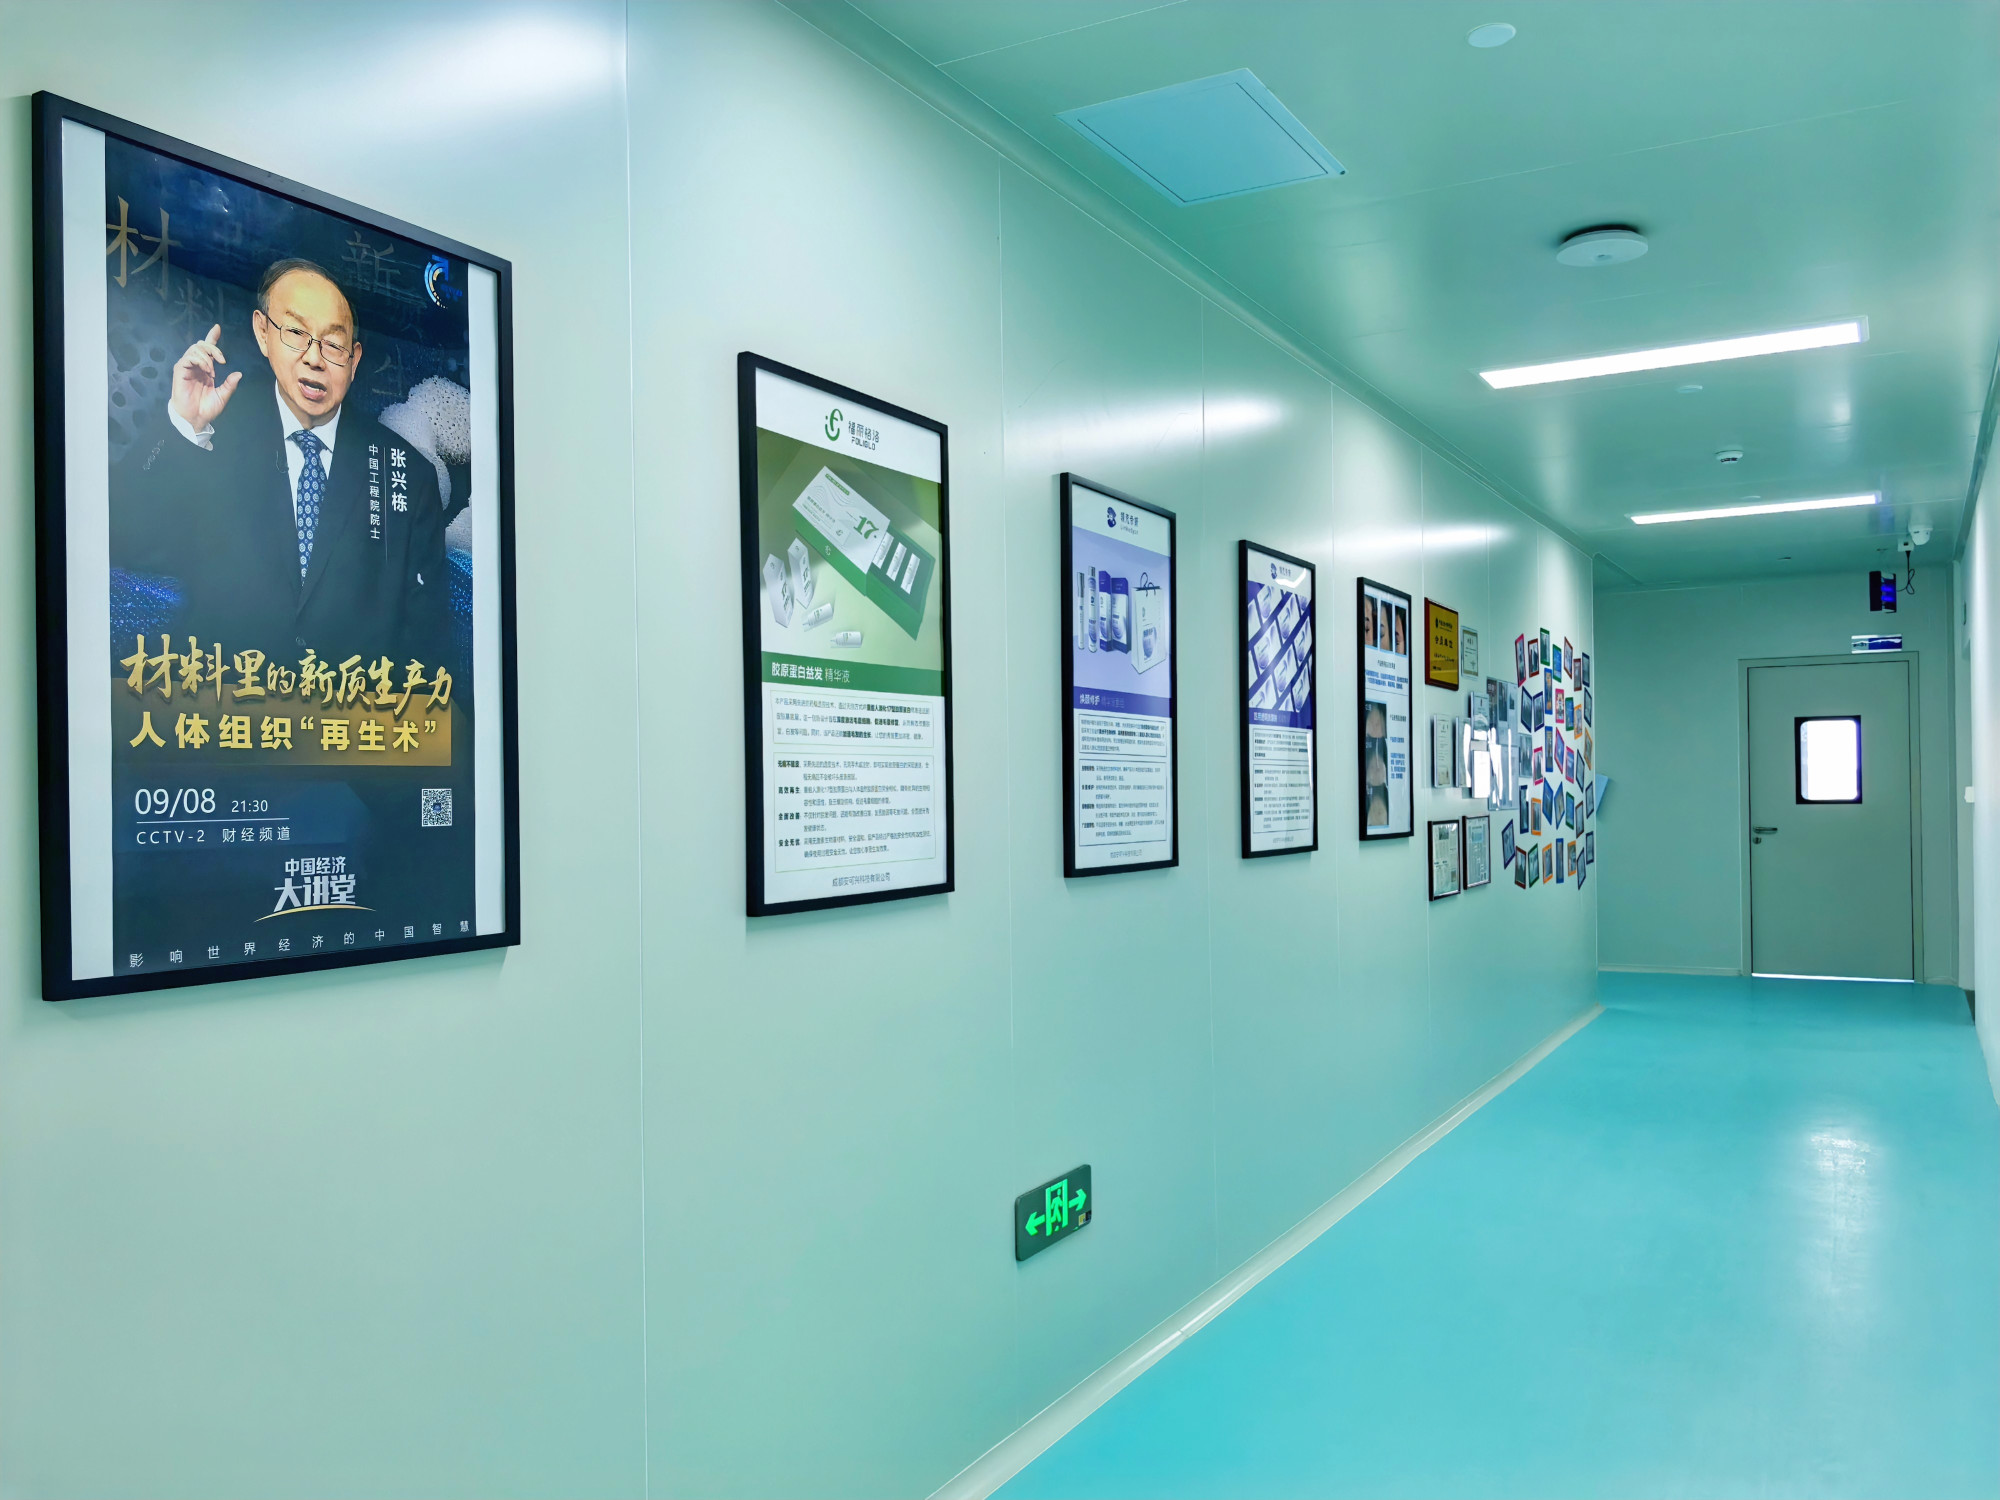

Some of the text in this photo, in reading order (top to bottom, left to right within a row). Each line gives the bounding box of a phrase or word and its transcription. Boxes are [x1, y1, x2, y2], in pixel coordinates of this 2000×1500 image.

[368, 444, 381, 540] 中国工程院院士
[390, 447, 408, 513] 张兴栋
[120, 633, 453, 716] 材料里的新质生产力
[771, 662, 823, 681] 胶原蛋白益发
[129, 711, 438, 753] 人体组织“再生术”
[134, 788, 269, 817] 09/08 21:30
[136, 826, 291, 845] CCTV-2 财经频道
[284, 856, 347, 876] 中国经济
[273, 873, 356, 913] 大讲堂
[129, 919, 470, 968] 影响世界经济的中国智慧
